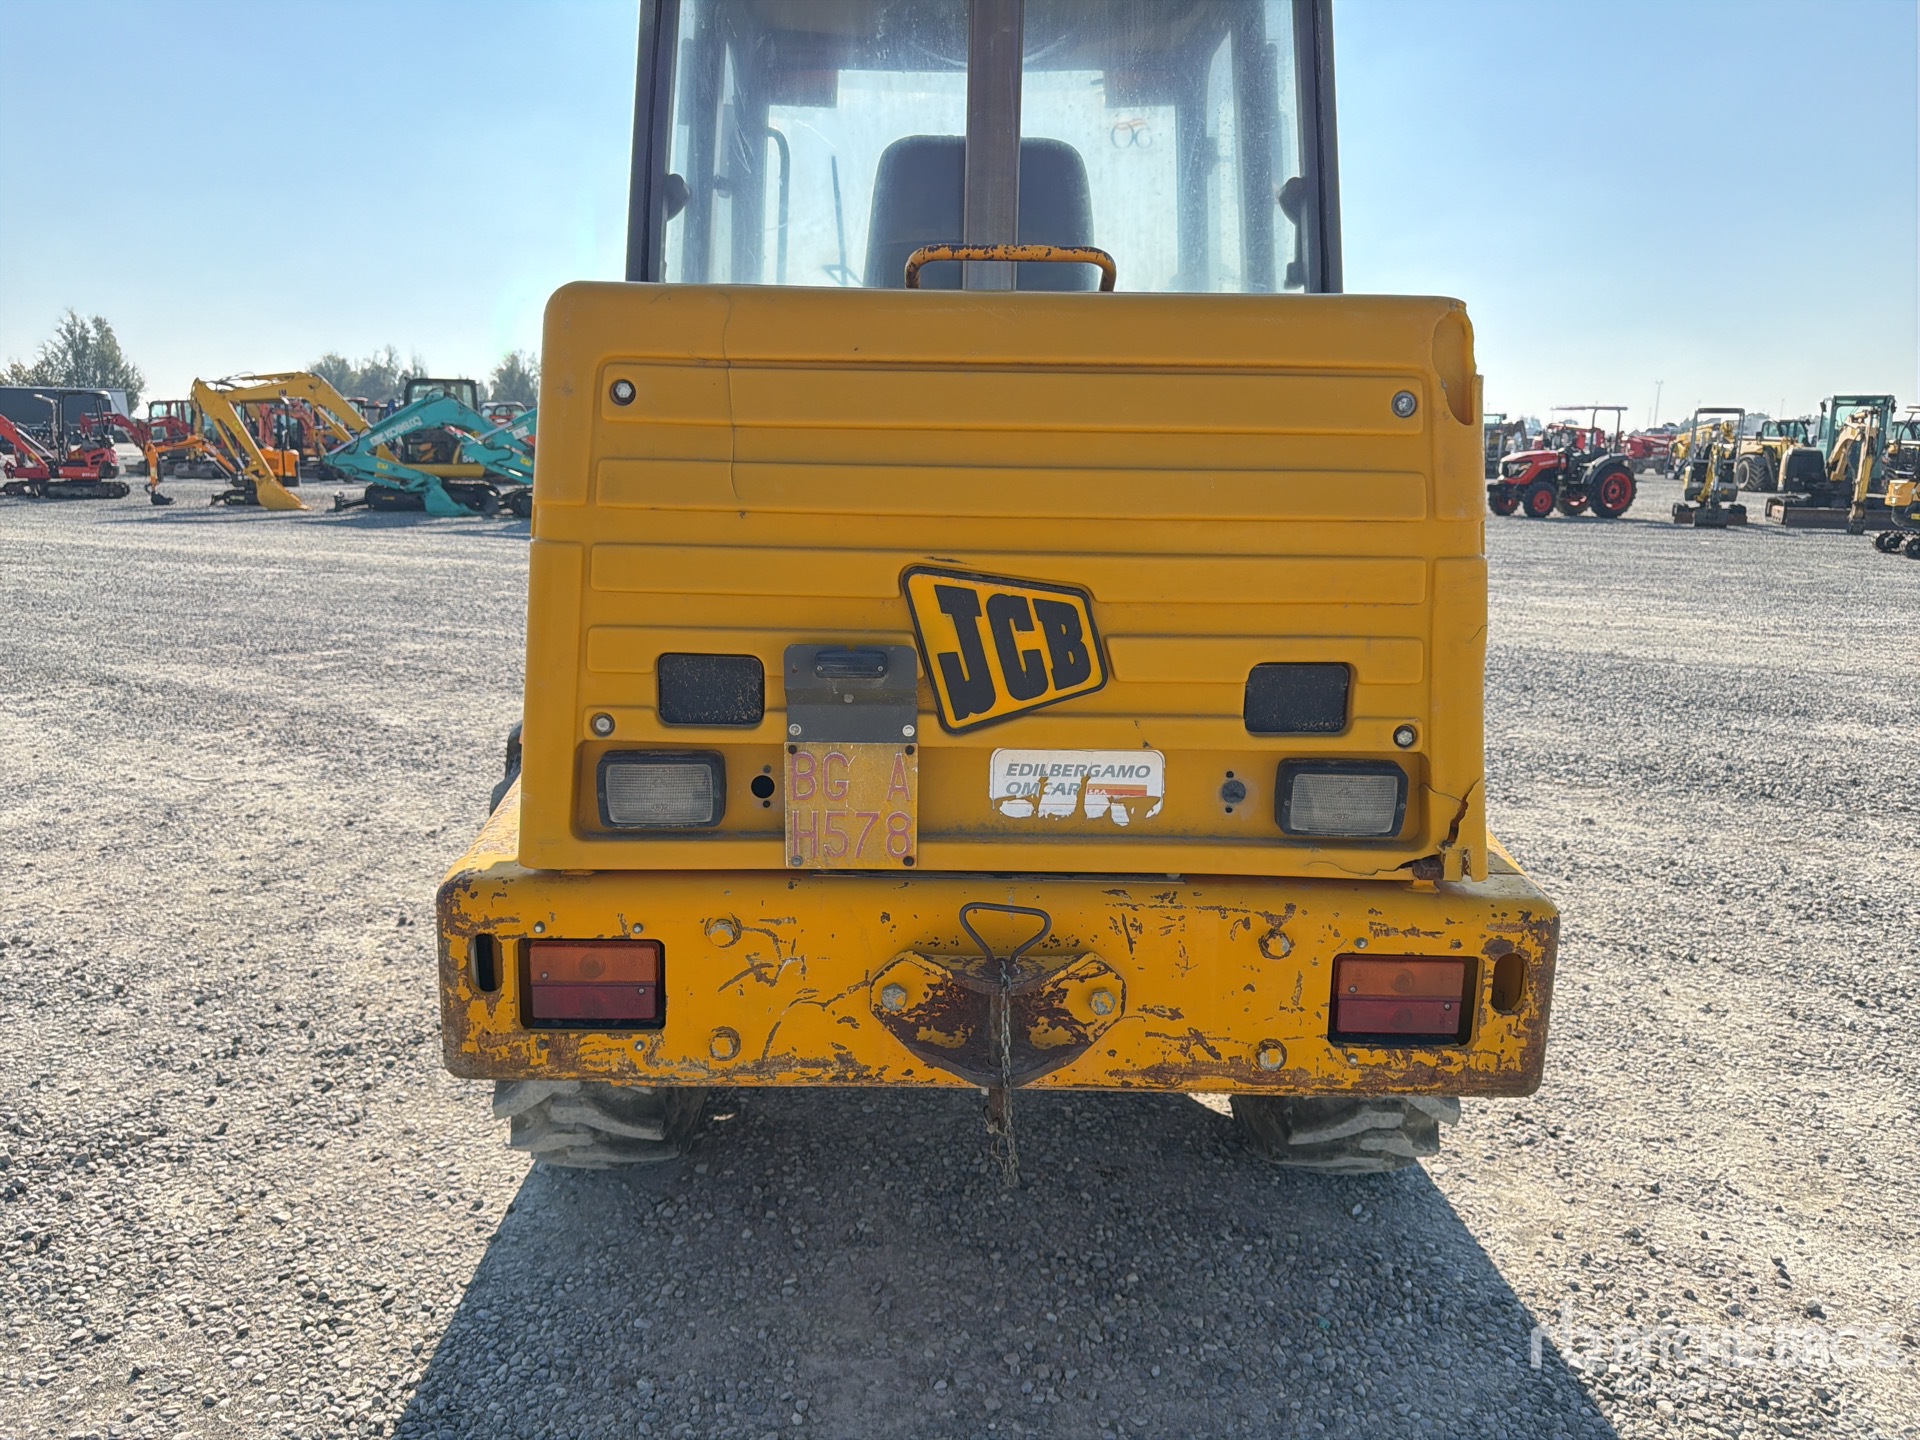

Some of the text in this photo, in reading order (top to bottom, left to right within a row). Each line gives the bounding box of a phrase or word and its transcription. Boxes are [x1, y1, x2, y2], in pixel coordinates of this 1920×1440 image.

[933, 584, 1092, 722] JCB
[791, 751, 911, 802] BG A
[1005, 762, 1151, 779] EDILBERGAMO
[792, 810, 912, 858] H578
